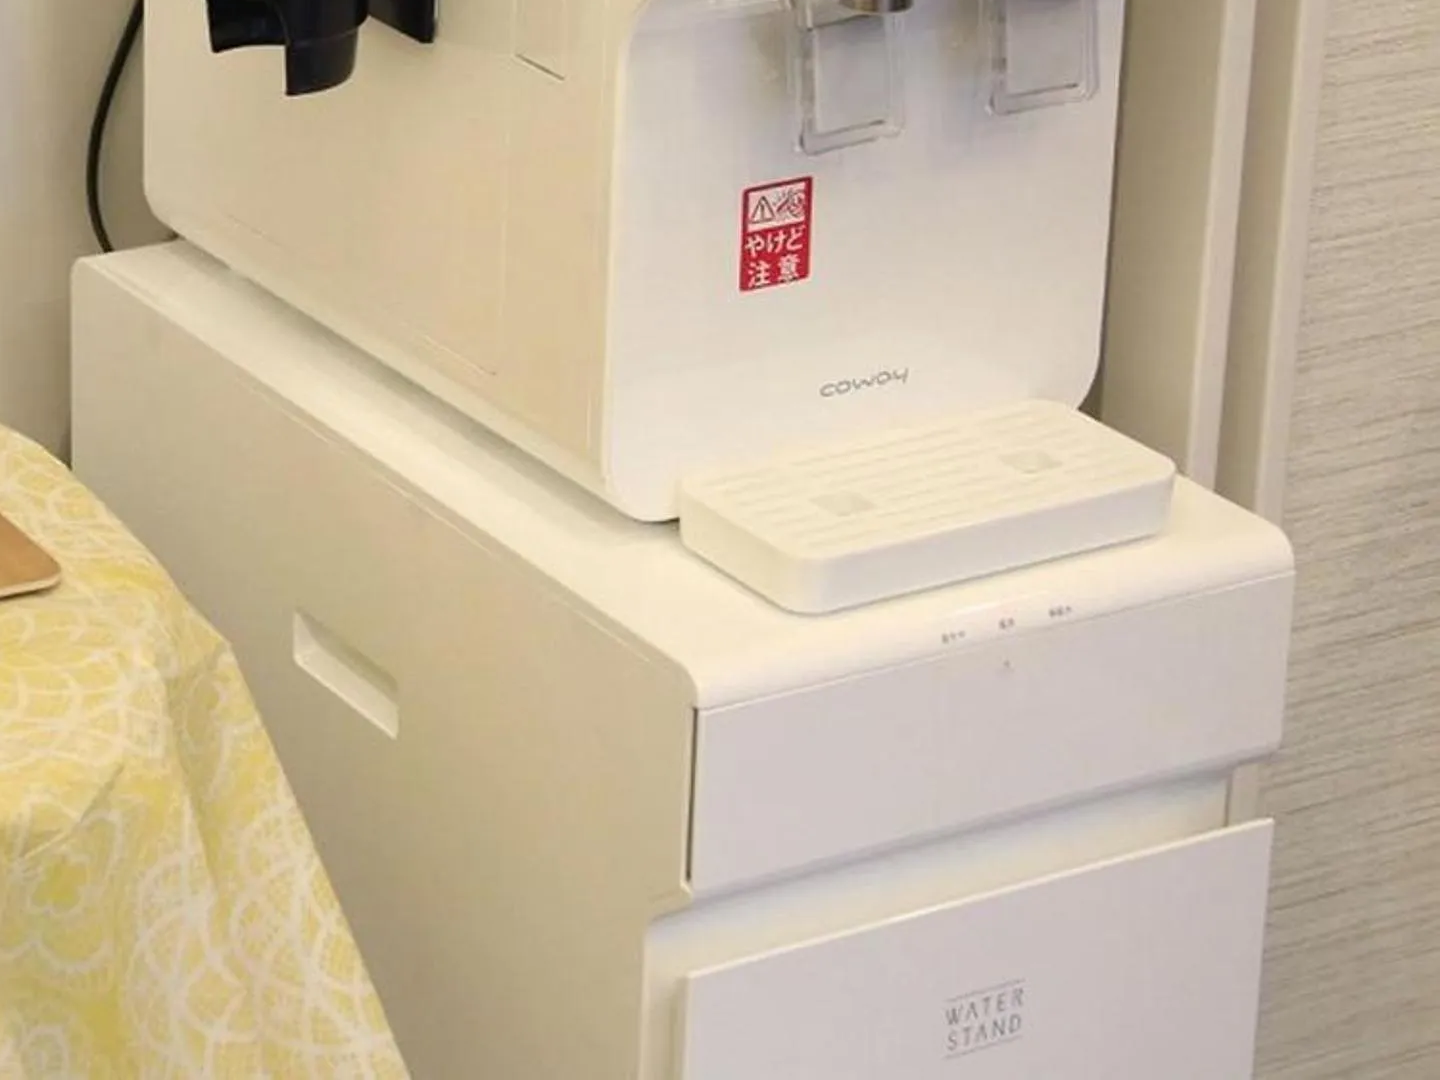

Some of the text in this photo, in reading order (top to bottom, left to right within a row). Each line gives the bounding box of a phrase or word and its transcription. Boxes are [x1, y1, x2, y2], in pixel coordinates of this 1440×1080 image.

[744, 224, 806, 258] やけど
[747, 254, 801, 288] 注意
[945, 987, 1024, 1026] WATER
[947, 1014, 1022, 1051] STAND
